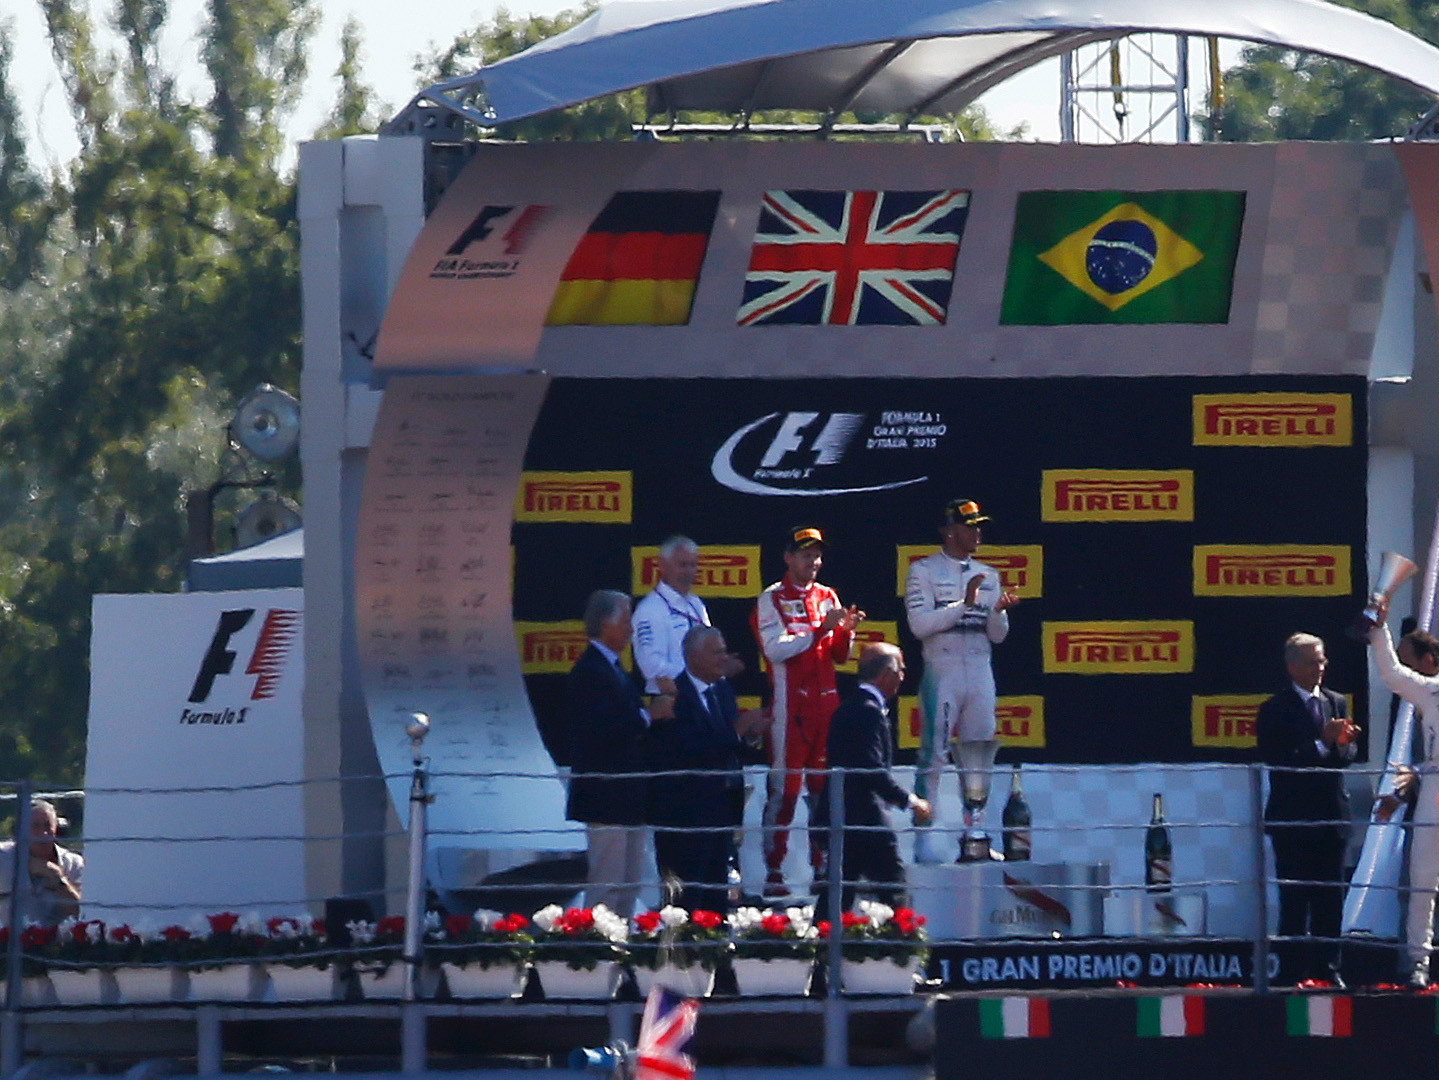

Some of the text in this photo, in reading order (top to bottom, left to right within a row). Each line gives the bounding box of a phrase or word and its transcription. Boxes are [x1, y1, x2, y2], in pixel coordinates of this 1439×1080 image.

[882, 411, 933, 424] FORMULA
[906, 424, 947, 436] PREMIO
[1204, 403, 1337, 436] PIRELLI
[912, 438, 937, 448] 2015
[524, 481, 622, 512] PIRELLI
[1055, 479, 1180, 511] PIRELLI
[1206, 554, 1337, 586] PIRELLI
[1055, 631, 1180, 663] PIRELLI
[180, 706, 249, 725] Formula 1
[963, 956, 1040, 983] GRAN
[1049, 953, 1143, 980] PREMIO
[1151, 952, 1242, 978] D'ITALIA
